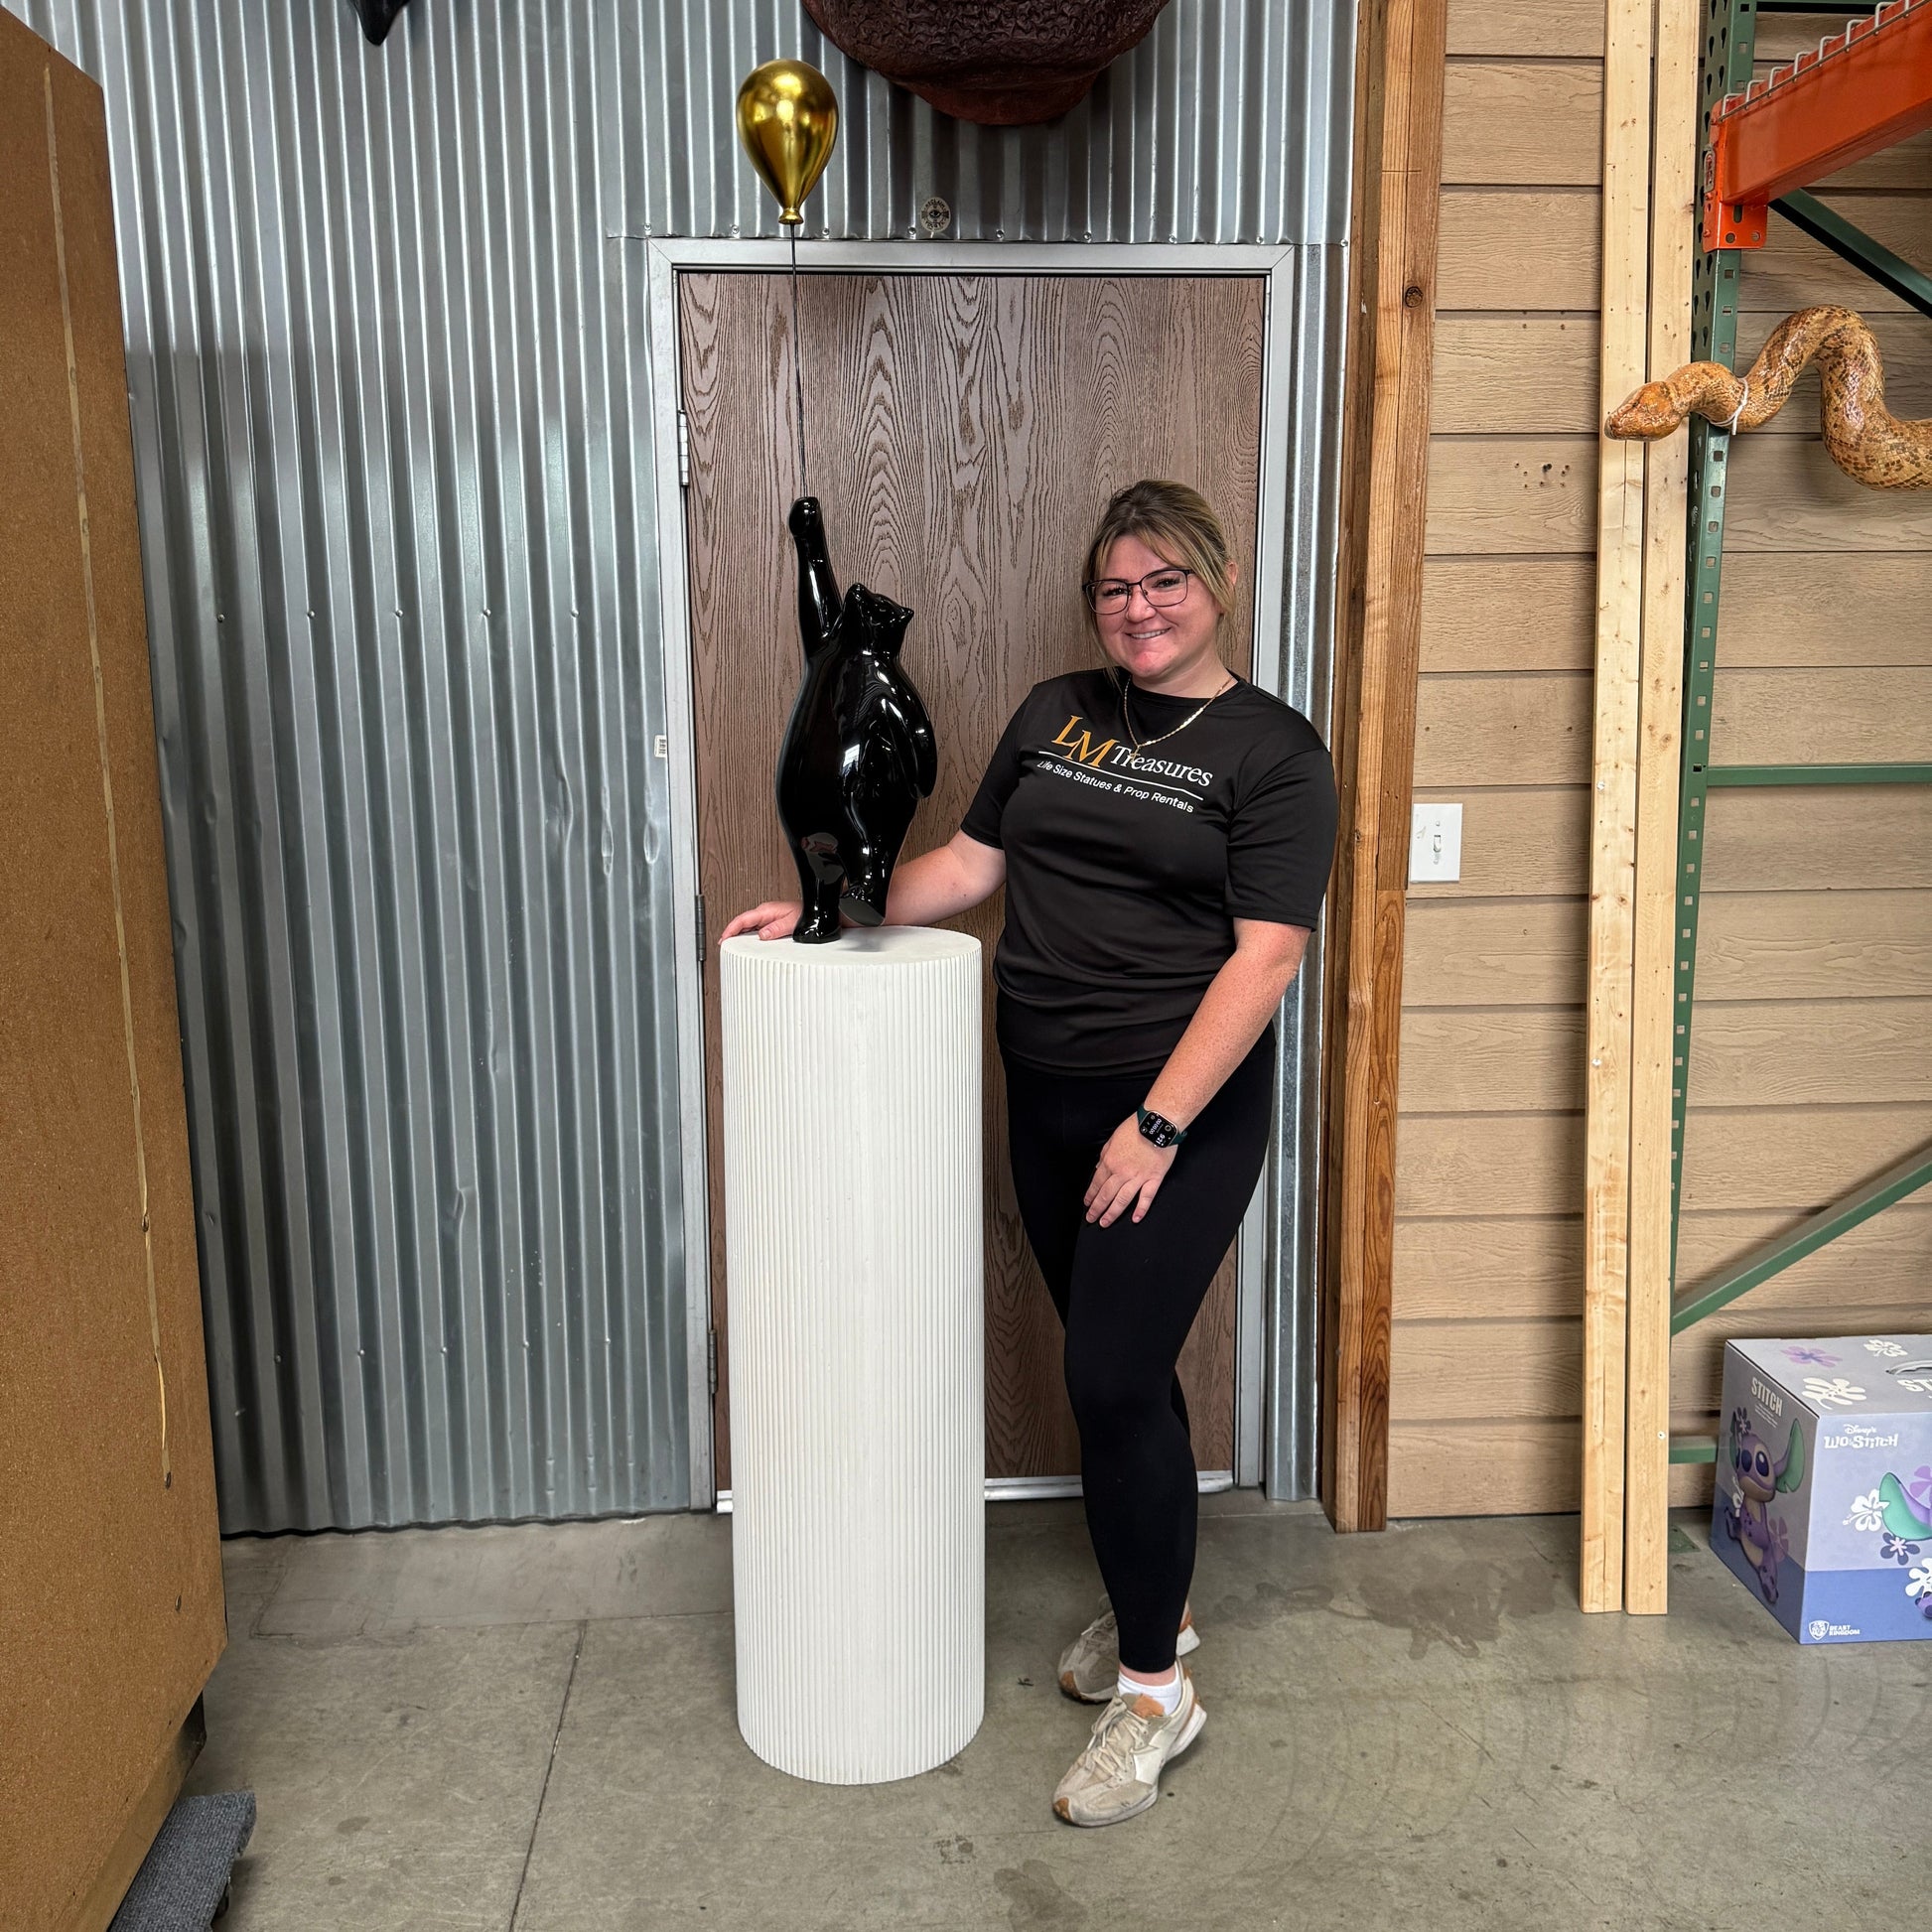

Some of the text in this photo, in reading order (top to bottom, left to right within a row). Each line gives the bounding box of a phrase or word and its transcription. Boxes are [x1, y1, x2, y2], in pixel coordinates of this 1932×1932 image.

[1051, 715, 1214, 787] LM Treasures
[1036, 760, 1194, 813] Life Size Statues & Prop Rentals
[1751, 1377, 1783, 1417] STITCH
